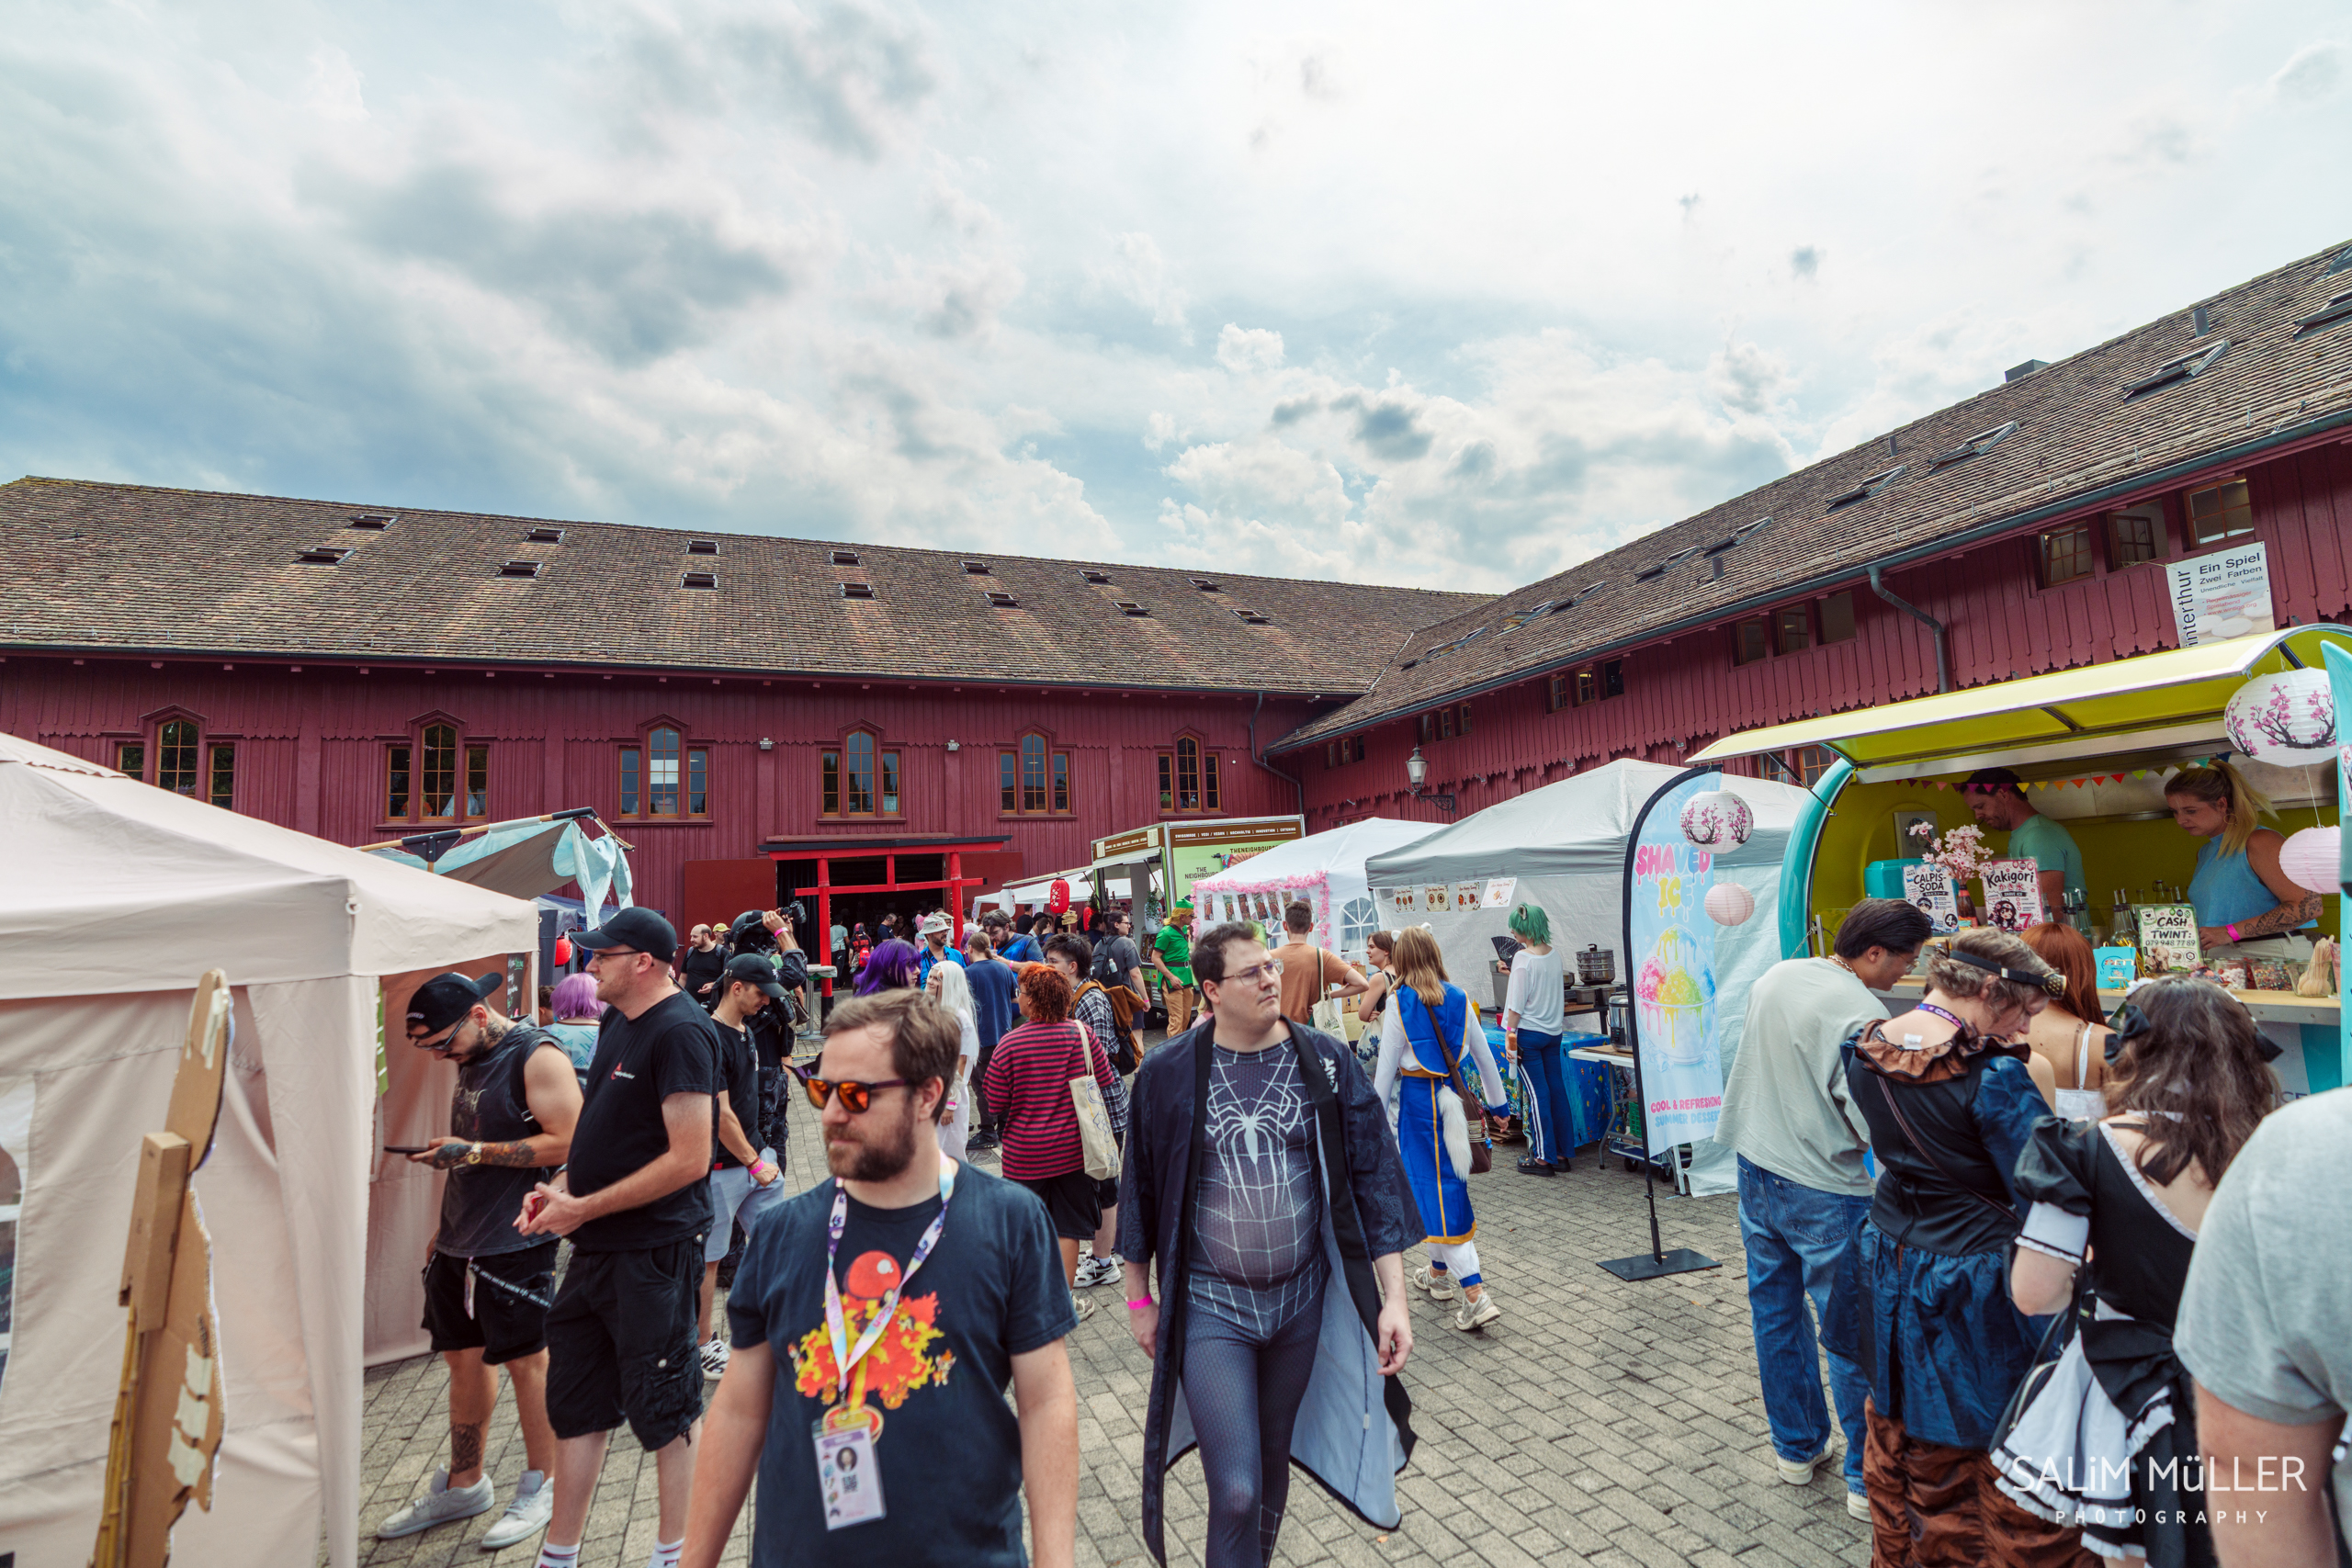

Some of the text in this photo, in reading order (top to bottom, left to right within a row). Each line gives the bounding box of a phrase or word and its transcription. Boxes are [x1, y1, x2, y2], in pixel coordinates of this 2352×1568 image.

[2199, 552, 2260, 574] Ein Spiel
[2199, 566, 2262, 585] Zwei Farben
[2200, 576, 2264, 593] Unendliche Vielfalt
[2206, 591, 2252, 604] Regelmässiger
[2206, 599, 2241, 611] Spielabend
[2177, 570, 2199, 647] interthur
[1634, 844, 1711, 886] SHAVED
[1914, 873, 1947, 885] CALPIS-
[1919, 882, 1944, 892] SODA
[1985, 870, 2034, 888] Kakigōri
[1658, 874, 1694, 922] ICE
[1946, 915, 1952, 926] 4
[2019, 913, 2031, 929] 7
[2157, 917, 2188, 927] CASH
[2151, 931, 2192, 939] TWINT:
[1651, 1096, 1721, 1113] COOL & REFRESHING
[1655, 1113, 1688, 1128] SUMMER
